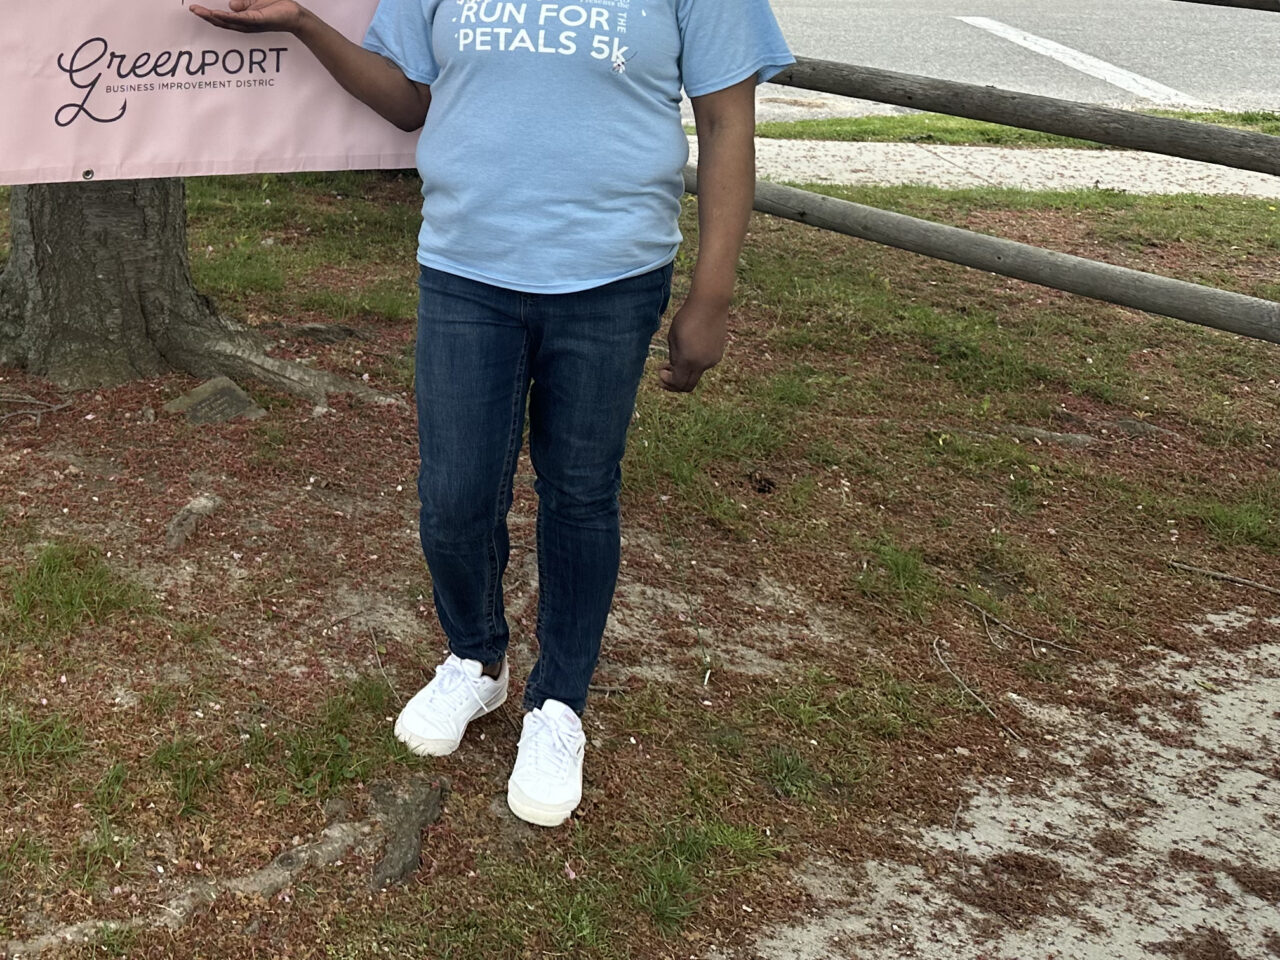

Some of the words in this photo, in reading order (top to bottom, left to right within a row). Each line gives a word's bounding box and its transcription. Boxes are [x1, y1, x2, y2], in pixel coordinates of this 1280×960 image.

[460, 1, 527, 24] RUN
[538, 3, 609, 31] FOR
[617, 12, 627, 33] THE
[459, 27, 577, 55] PETALS
[590, 35, 630, 63] 5k
[105, 83, 155, 93] BUSINESS
[158, 80, 231, 91] IMPROVEMENT
[236, 78, 275, 88] DISTRIC
